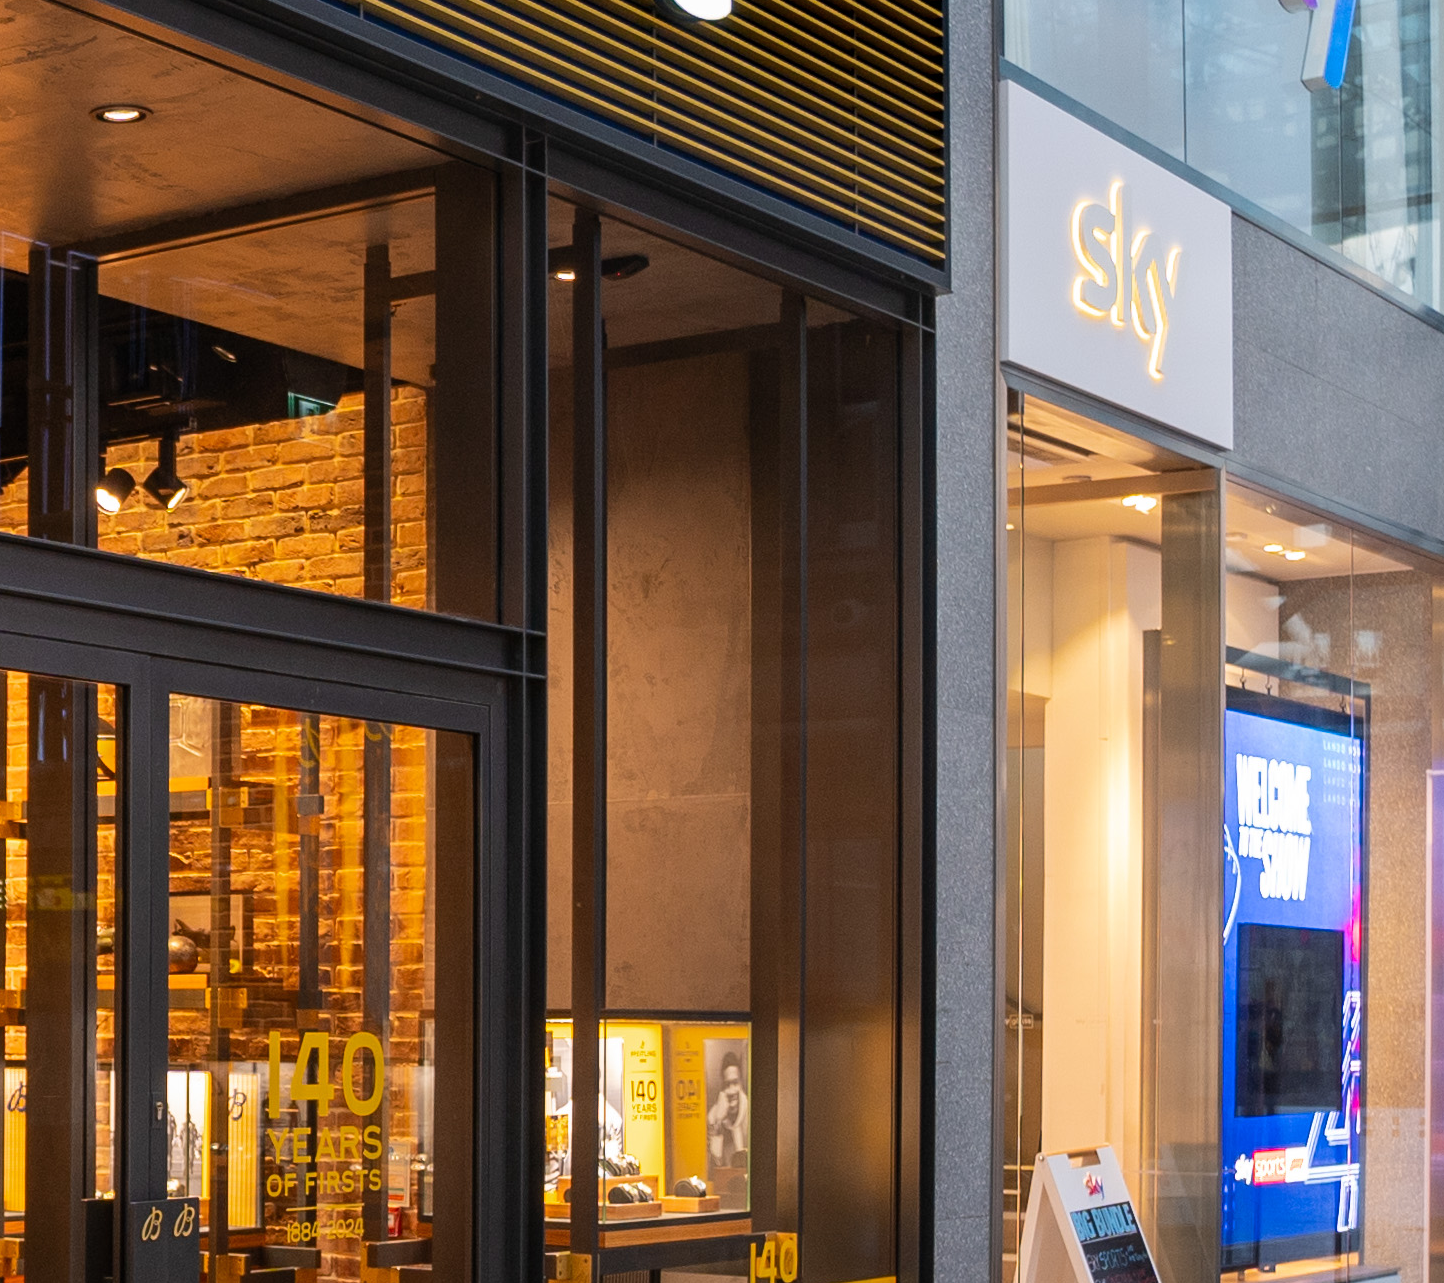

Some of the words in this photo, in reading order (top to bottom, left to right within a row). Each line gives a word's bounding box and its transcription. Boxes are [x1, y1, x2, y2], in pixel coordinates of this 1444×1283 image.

[1071, 179, 1180, 380] sky
[1236, 753, 1312, 836] WELCOME
[1259, 829, 1312, 901] SHOW
[268, 1031, 385, 1119] 140
[631, 1080, 657, 1102] 140
[632, 1103, 658, 1114] YEARS
[266, 1125, 383, 1164] YEARS
[266, 1173, 297, 1198] OF
[305, 1169, 382, 1195] FIRSTS
[1255, 1157, 1285, 1181] sports
[1070, 1209, 1096, 1242] BIG
[1092, 1203, 1138, 1238] BUNDLE
